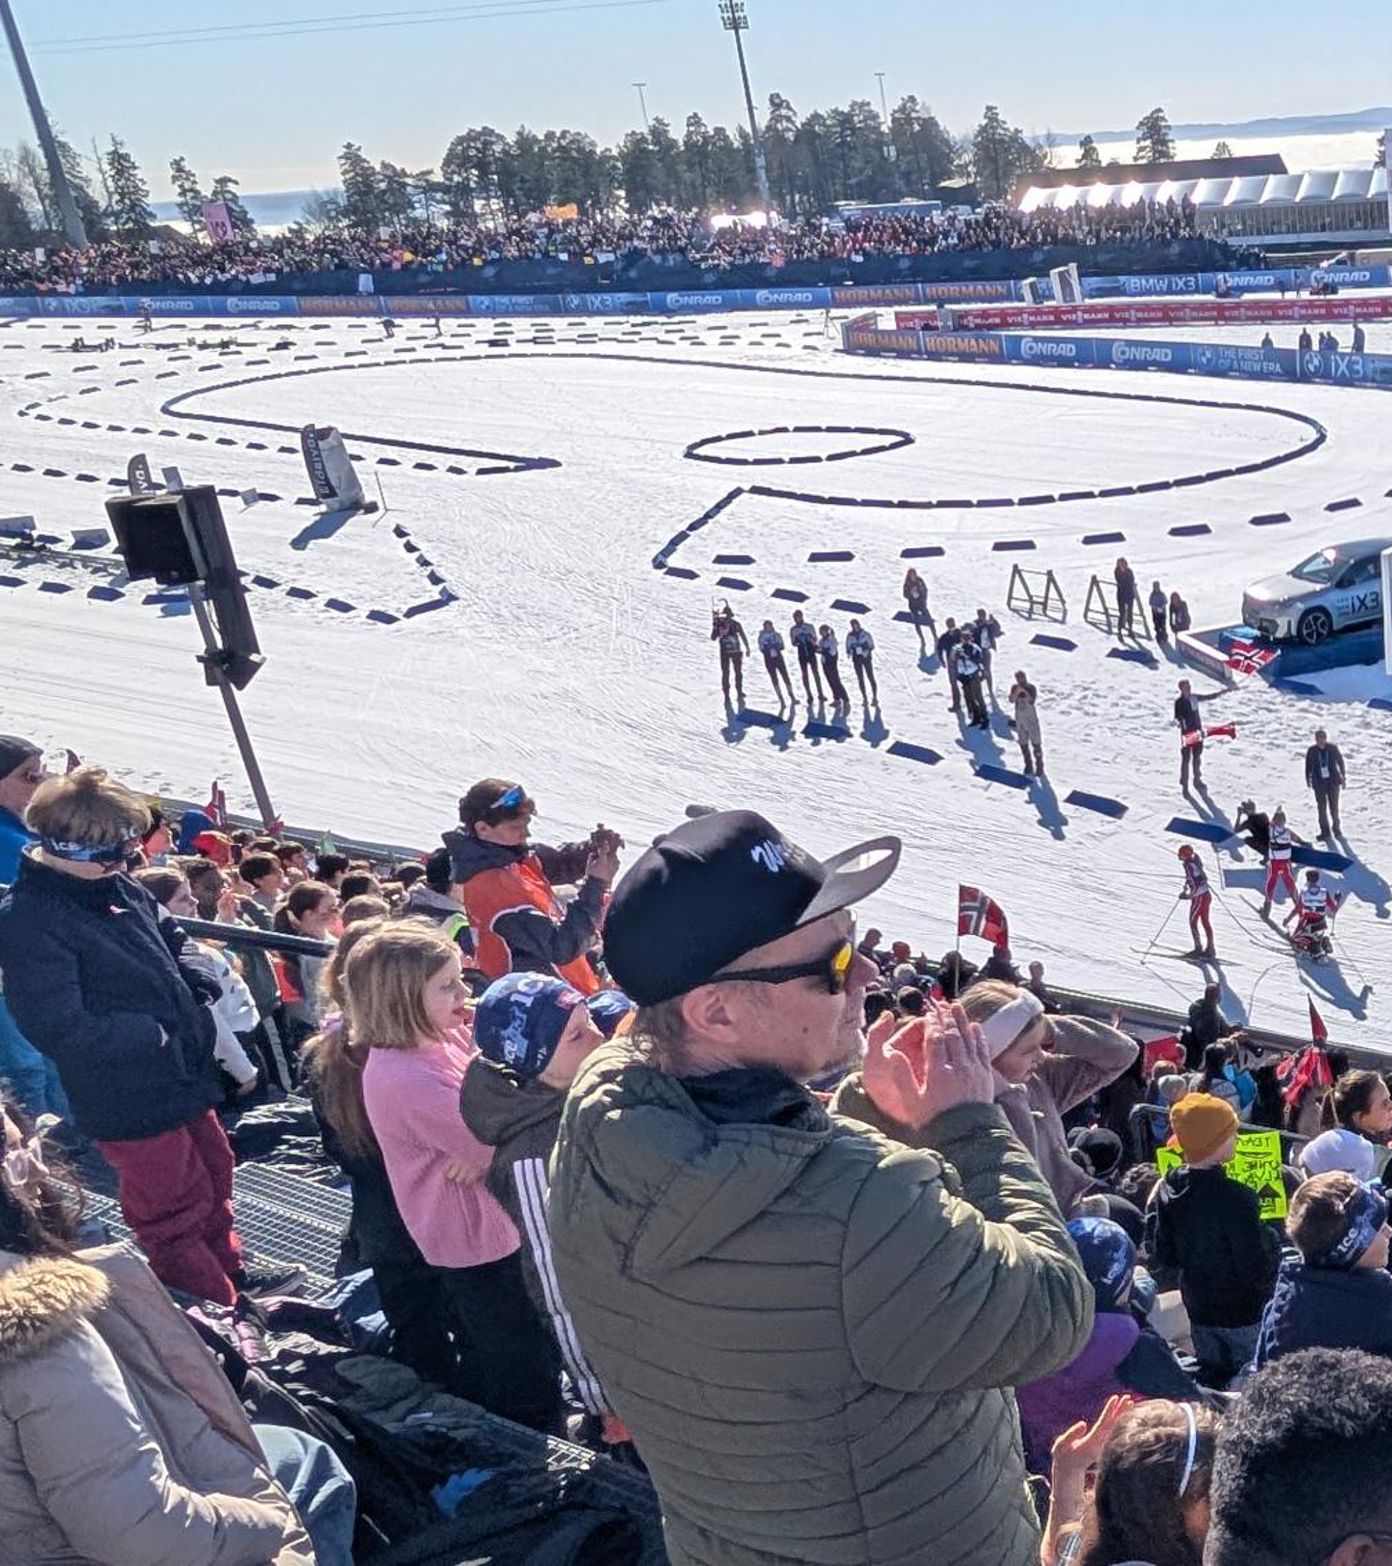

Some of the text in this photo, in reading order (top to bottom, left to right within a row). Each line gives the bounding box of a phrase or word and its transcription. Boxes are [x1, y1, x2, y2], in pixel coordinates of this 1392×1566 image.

[1130, 278, 1168, 292] BMW
[1020, 337, 1076, 358] CONRAD
[1112, 341, 1171, 363] CONRAD
[1219, 348, 1234, 359] THE
